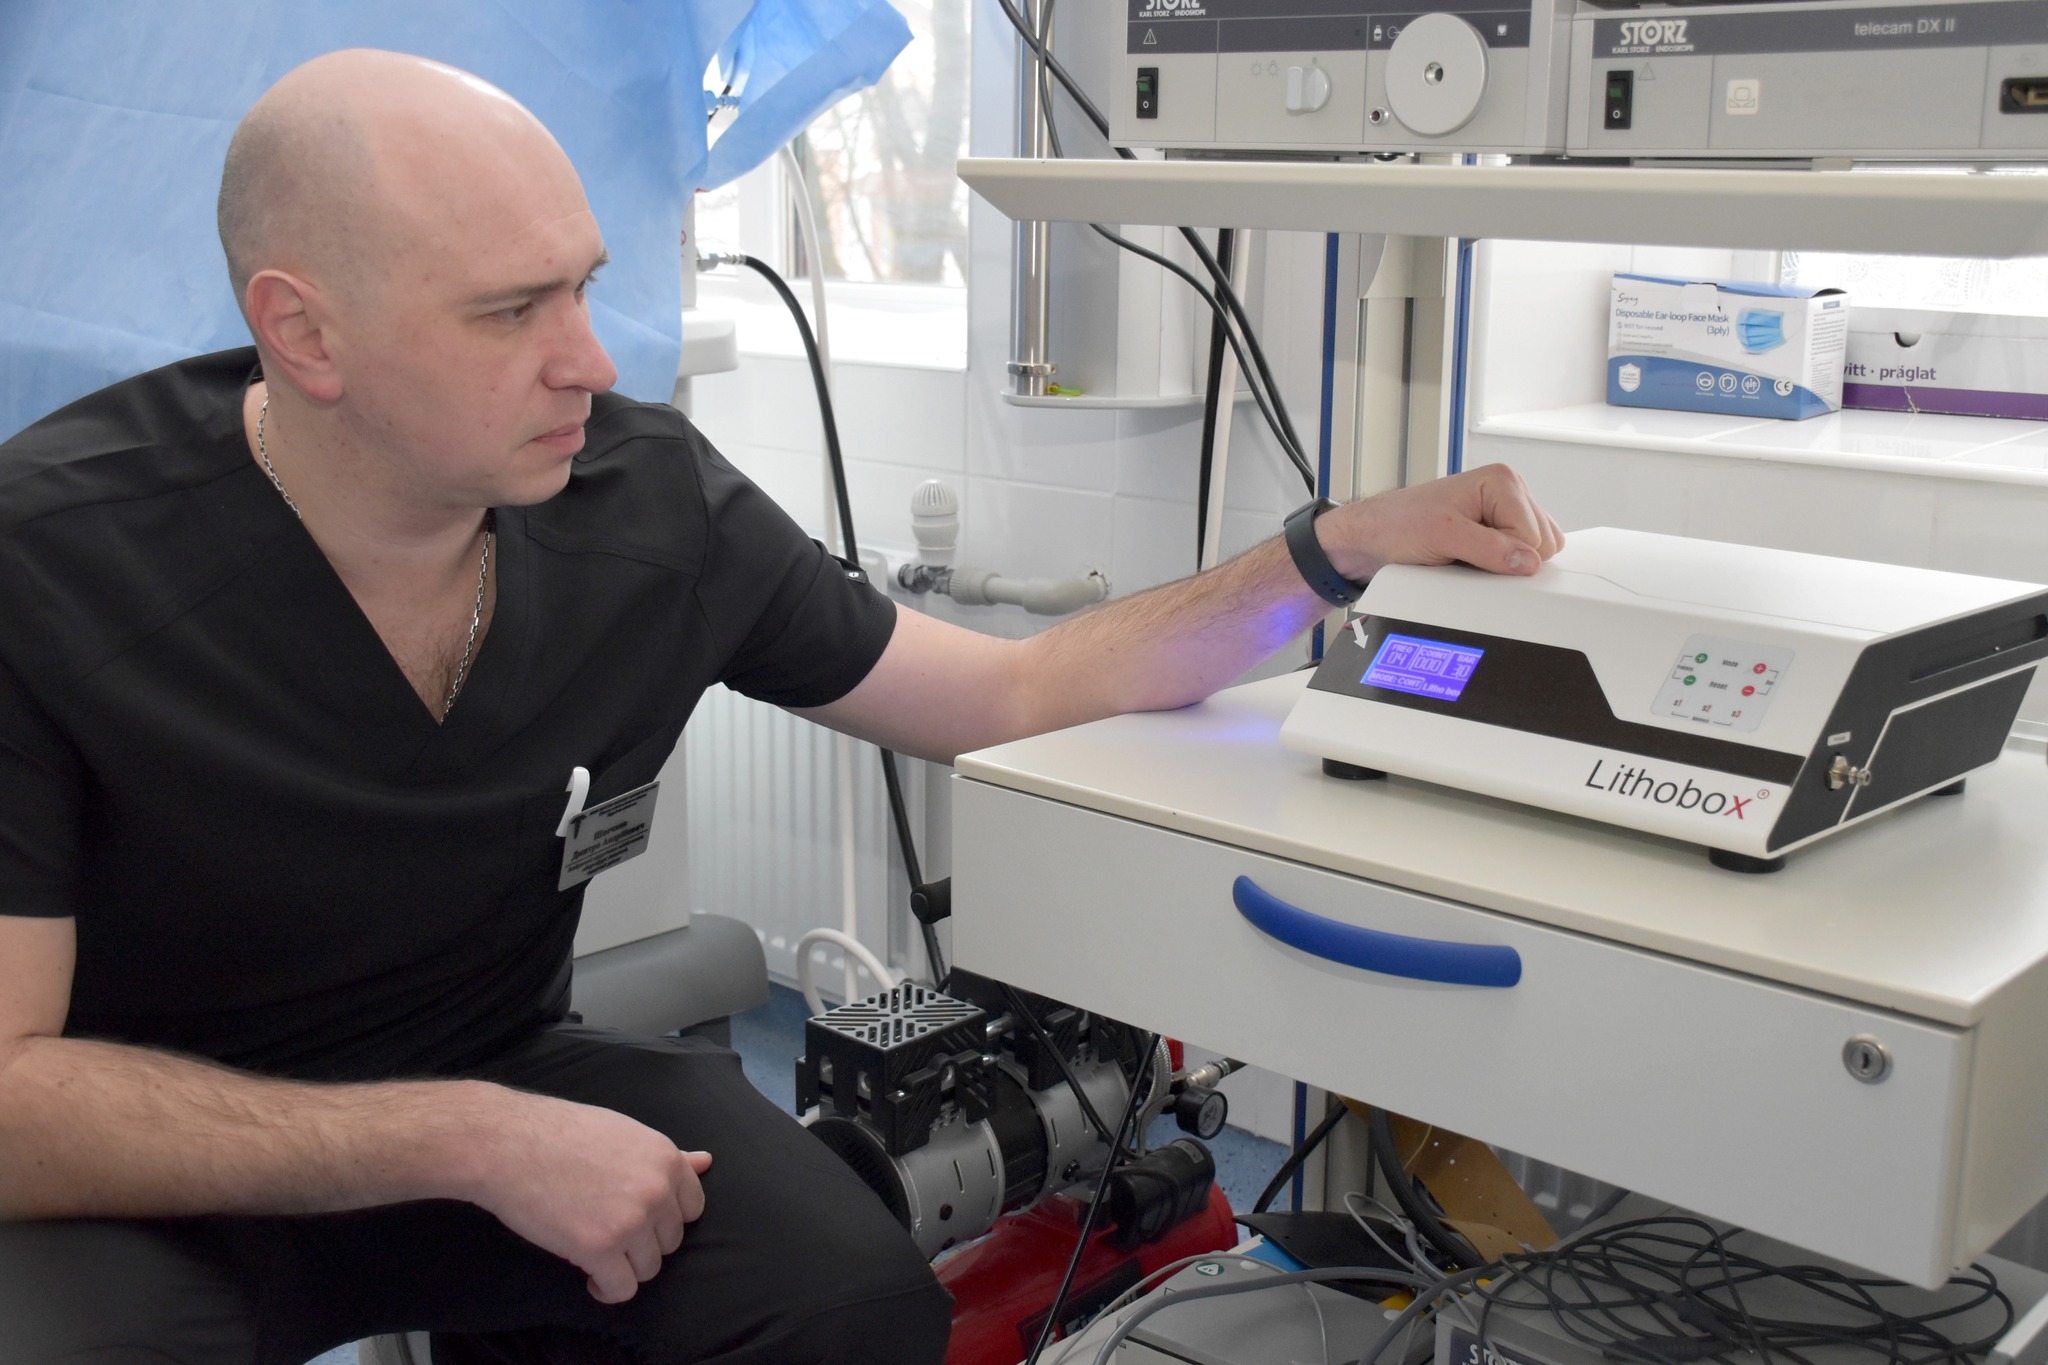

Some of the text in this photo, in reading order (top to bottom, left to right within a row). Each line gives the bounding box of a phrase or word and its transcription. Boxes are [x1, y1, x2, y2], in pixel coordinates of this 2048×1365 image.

[1620, 20, 1687, 45] STORZ
[1854, 22, 1913, 36] telecam
[1917, 19, 1940, 33] DX
[1655, 44, 1694, 52] ENDOSKOPE
[1615, 308, 1729, 323] Disposable Ear-loop Face Mask
[1706, 326, 1730, 337] (3ply)
[1391, 643, 1413, 653] FREQ
[1420, 649, 1449, 659] COUNT
[1456, 655, 1475, 664] BAR
[1415, 657, 1442, 672] 000
[1370, 671, 1421, 687] MODE: CONT
[1709, 681, 1728, 690] Reset
